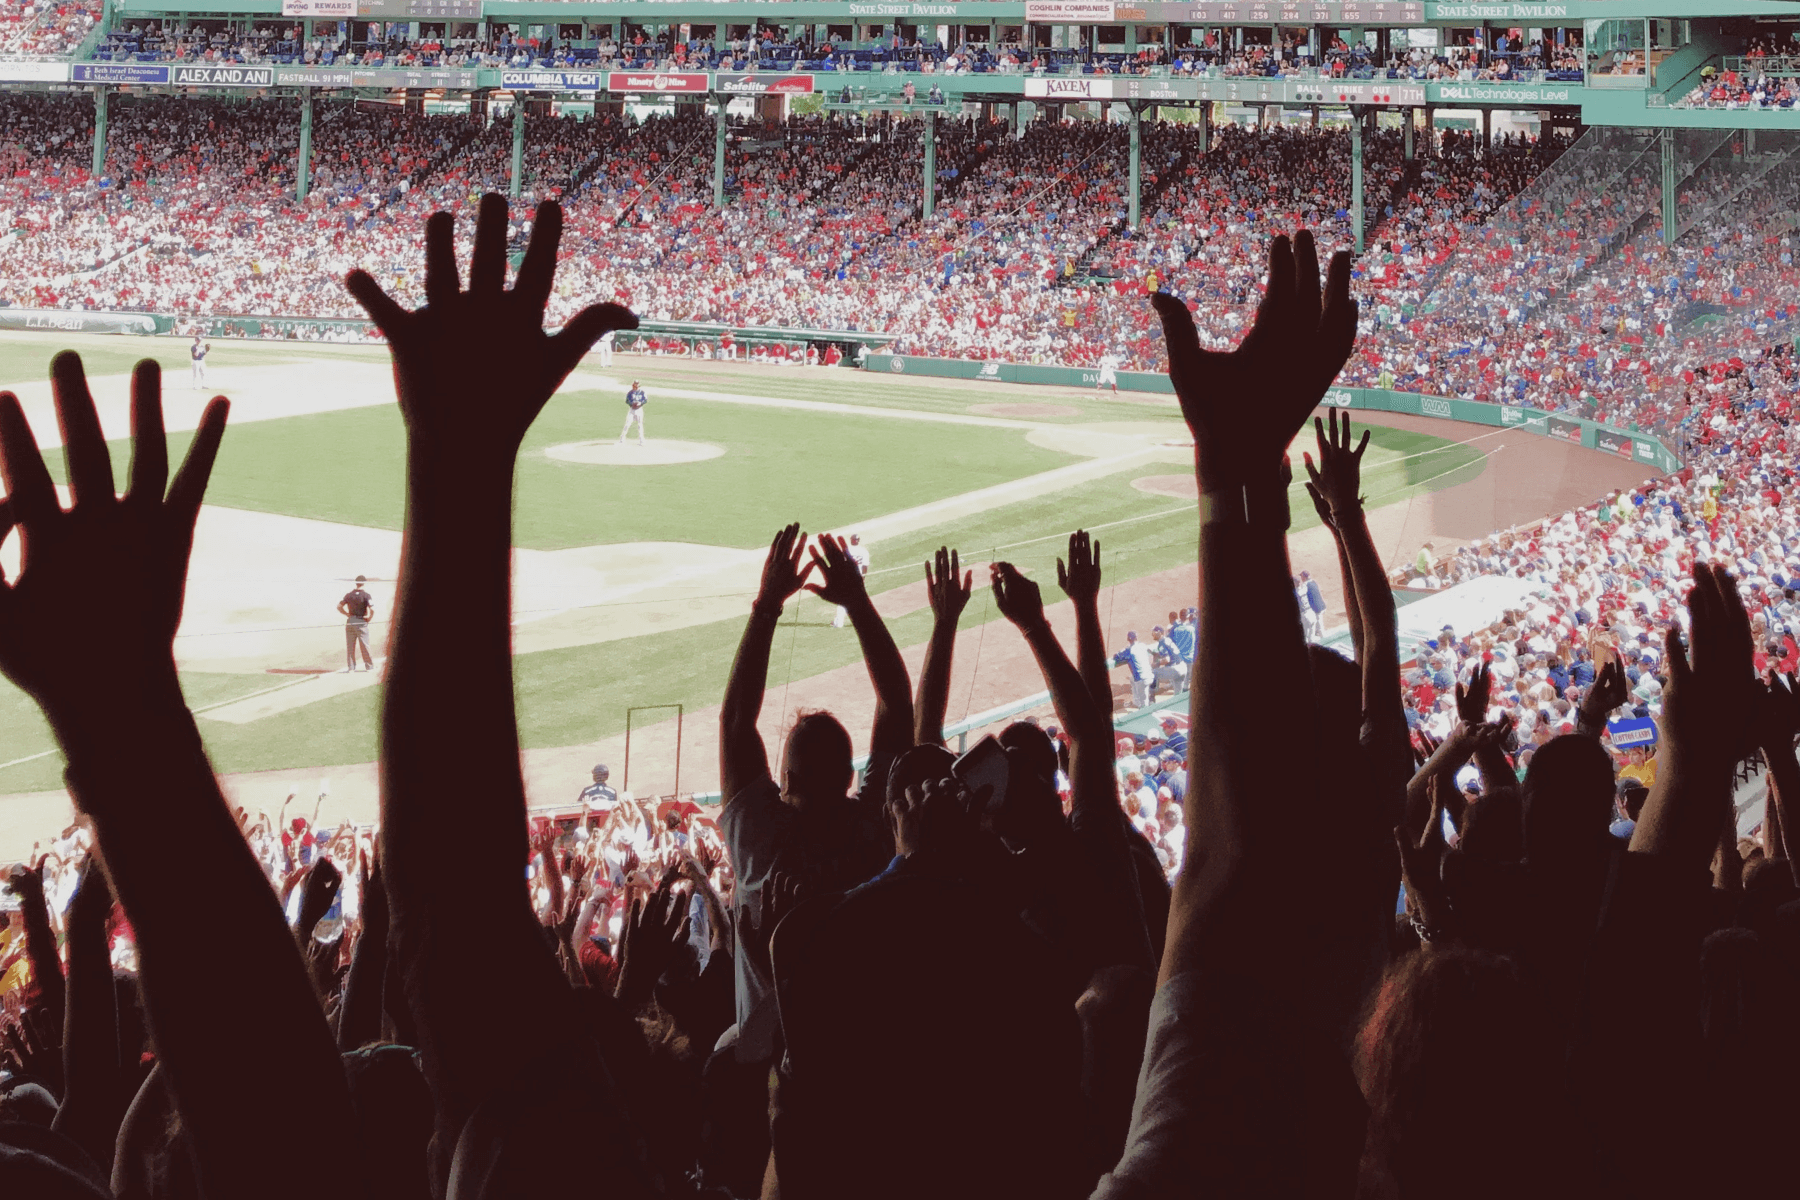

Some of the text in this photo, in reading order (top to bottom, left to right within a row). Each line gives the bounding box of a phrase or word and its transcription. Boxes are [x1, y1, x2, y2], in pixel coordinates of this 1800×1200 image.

[849, 4, 957, 15] STATE STREET PAVILION
[1437, 4, 1567, 17] STATE STREET PAVILION
[1192, 11, 1207, 19] 103
[1281, 12, 1299, 20] .284
[1312, 12, 1329, 20] .371
[1341, 12, 1360, 20] .655
[128, 67, 159, 75] Deaconess
[178, 69, 268, 84] ALEX AND ANI
[279, 74, 320, 83] FASTBALL
[333, 75, 349, 83] MPH
[503, 74, 596, 85] COLUMBIA TECH
[627, 77, 654, 87] Ninety
[668, 78, 687, 86] Nine
[723, 81, 766, 91] Safelite
[1046, 80, 1091, 97] KAYEM
[1296, 85, 1391, 94] BALL STRIKE OUT
[1402, 89, 1424, 100] 7TH
[1440, 87, 1568, 102] DELL Technologies Level
